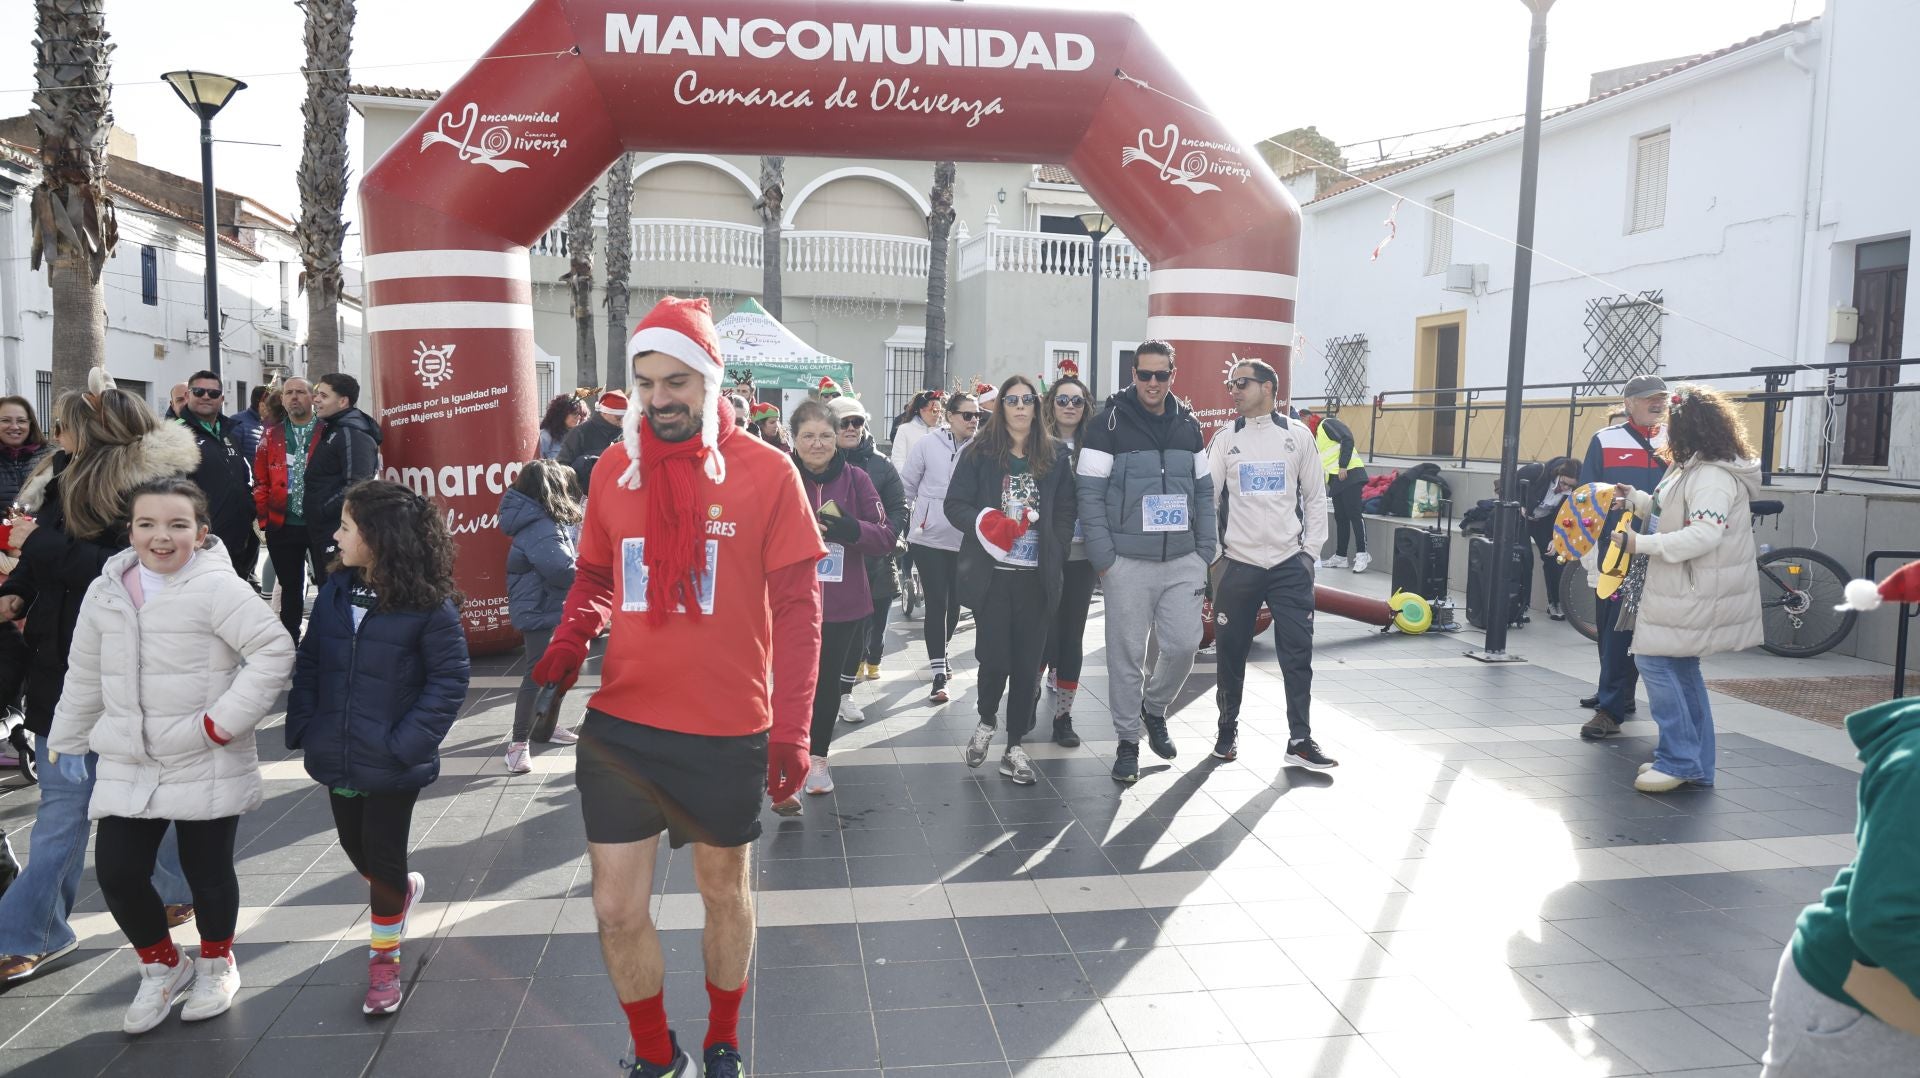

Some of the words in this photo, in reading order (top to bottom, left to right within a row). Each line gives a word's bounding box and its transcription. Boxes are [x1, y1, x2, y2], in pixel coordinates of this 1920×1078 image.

[605, 13, 1095, 71] MANCOMUNIDAD
[673, 70, 814, 109] Comarca
[825, 77, 859, 110] de
[870, 77, 1005, 129] Olivenza
[381, 402, 422, 417] Deportistas
[423, 399, 439, 409] por
[441, 397, 450, 405] la
[451, 390, 490, 405] Igualdad
[491, 385, 508, 395] Real
[390, 417, 410, 427] entre
[411, 411, 445, 424] Mujeres
[446, 411, 453, 419] y
[455, 399, 499, 415] Hombres!!
[1251, 476, 1281, 491] 97
[1153, 509, 1183, 525] 36
[705, 520, 737, 538] GRES
[462, 598, 486, 608] CIÓN
